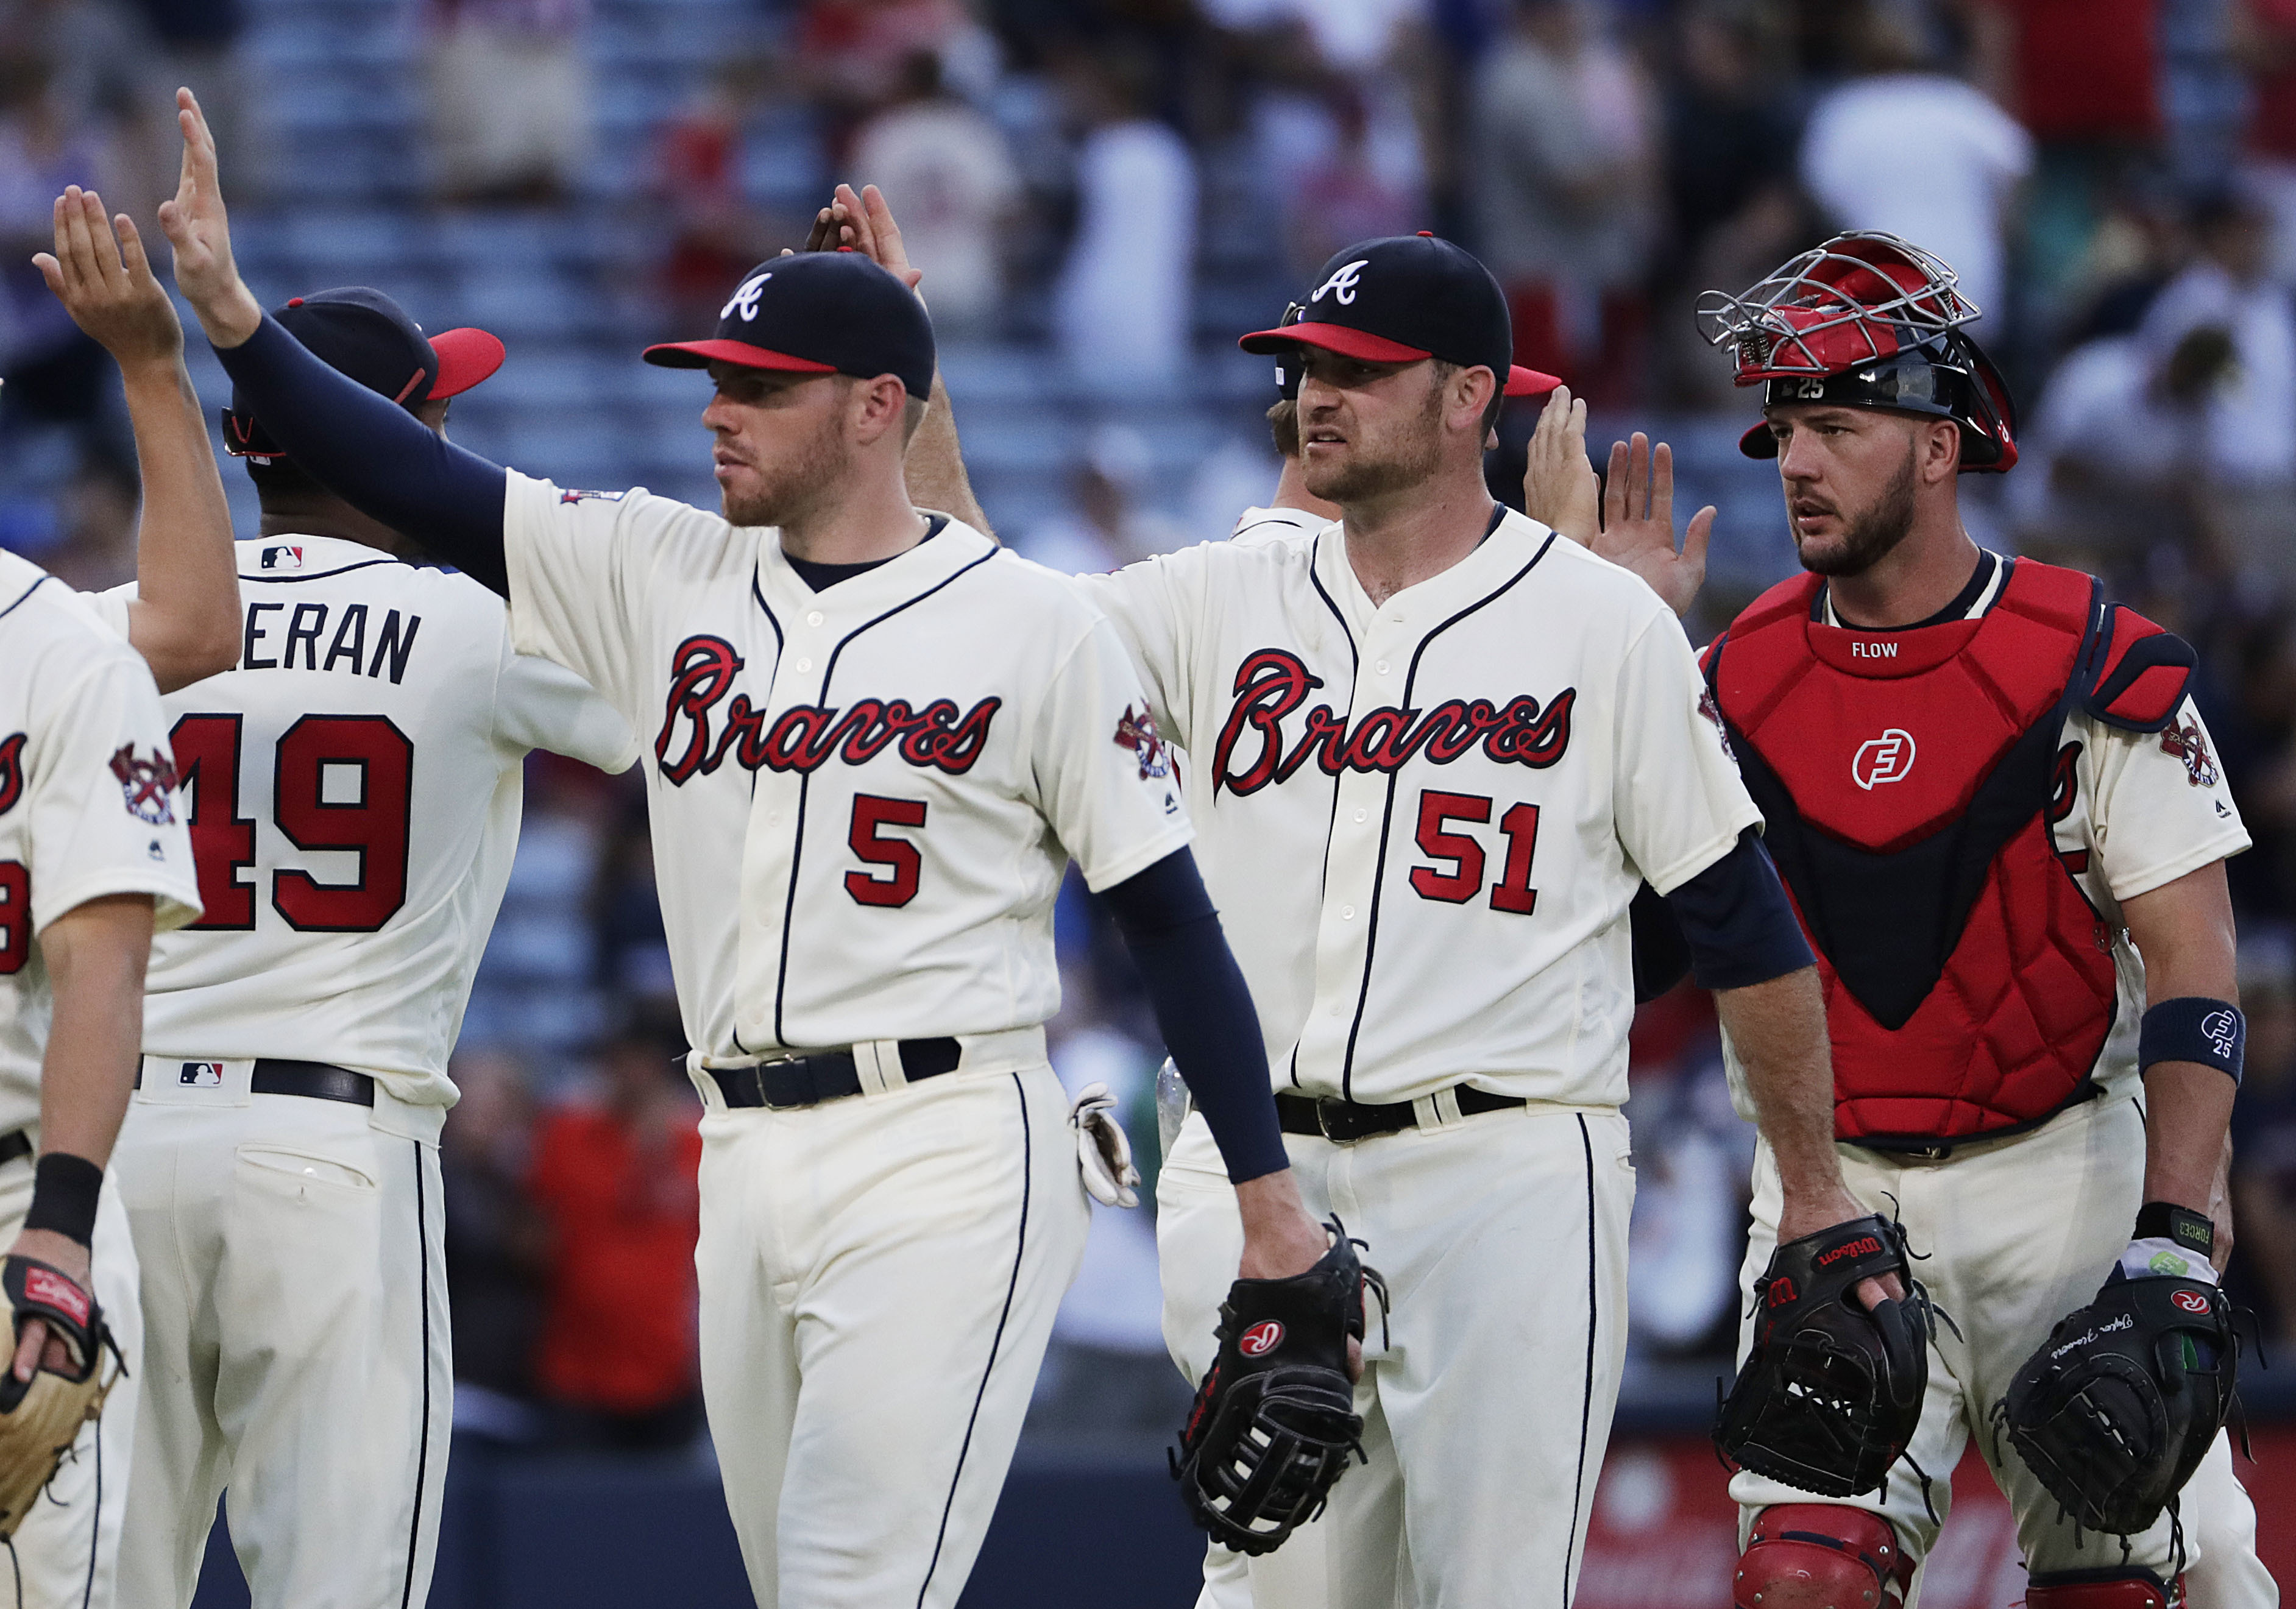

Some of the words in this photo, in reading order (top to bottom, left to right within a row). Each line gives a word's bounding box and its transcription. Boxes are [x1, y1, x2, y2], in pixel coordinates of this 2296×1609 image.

[720, 272, 773, 322] A
[1311, 260, 1369, 305] A
[1797, 377, 1826, 399] 25
[227, 603, 422, 685] ERAN
[1852, 642, 1898, 658] FLOW
[654, 634, 1002, 788] Braves
[1211, 648, 1577, 808] Braves
[844, 793, 927, 908] 5
[1409, 788, 1540, 916] 51
[2213, 1039, 2233, 1059] 25
[1818, 1237, 1881, 1266] Wilson
[2180, 1221, 2210, 1244] FORCE3
[2100, 1313, 2133, 1332] Tyler
[2050, 1328, 2099, 1360] Flowers
